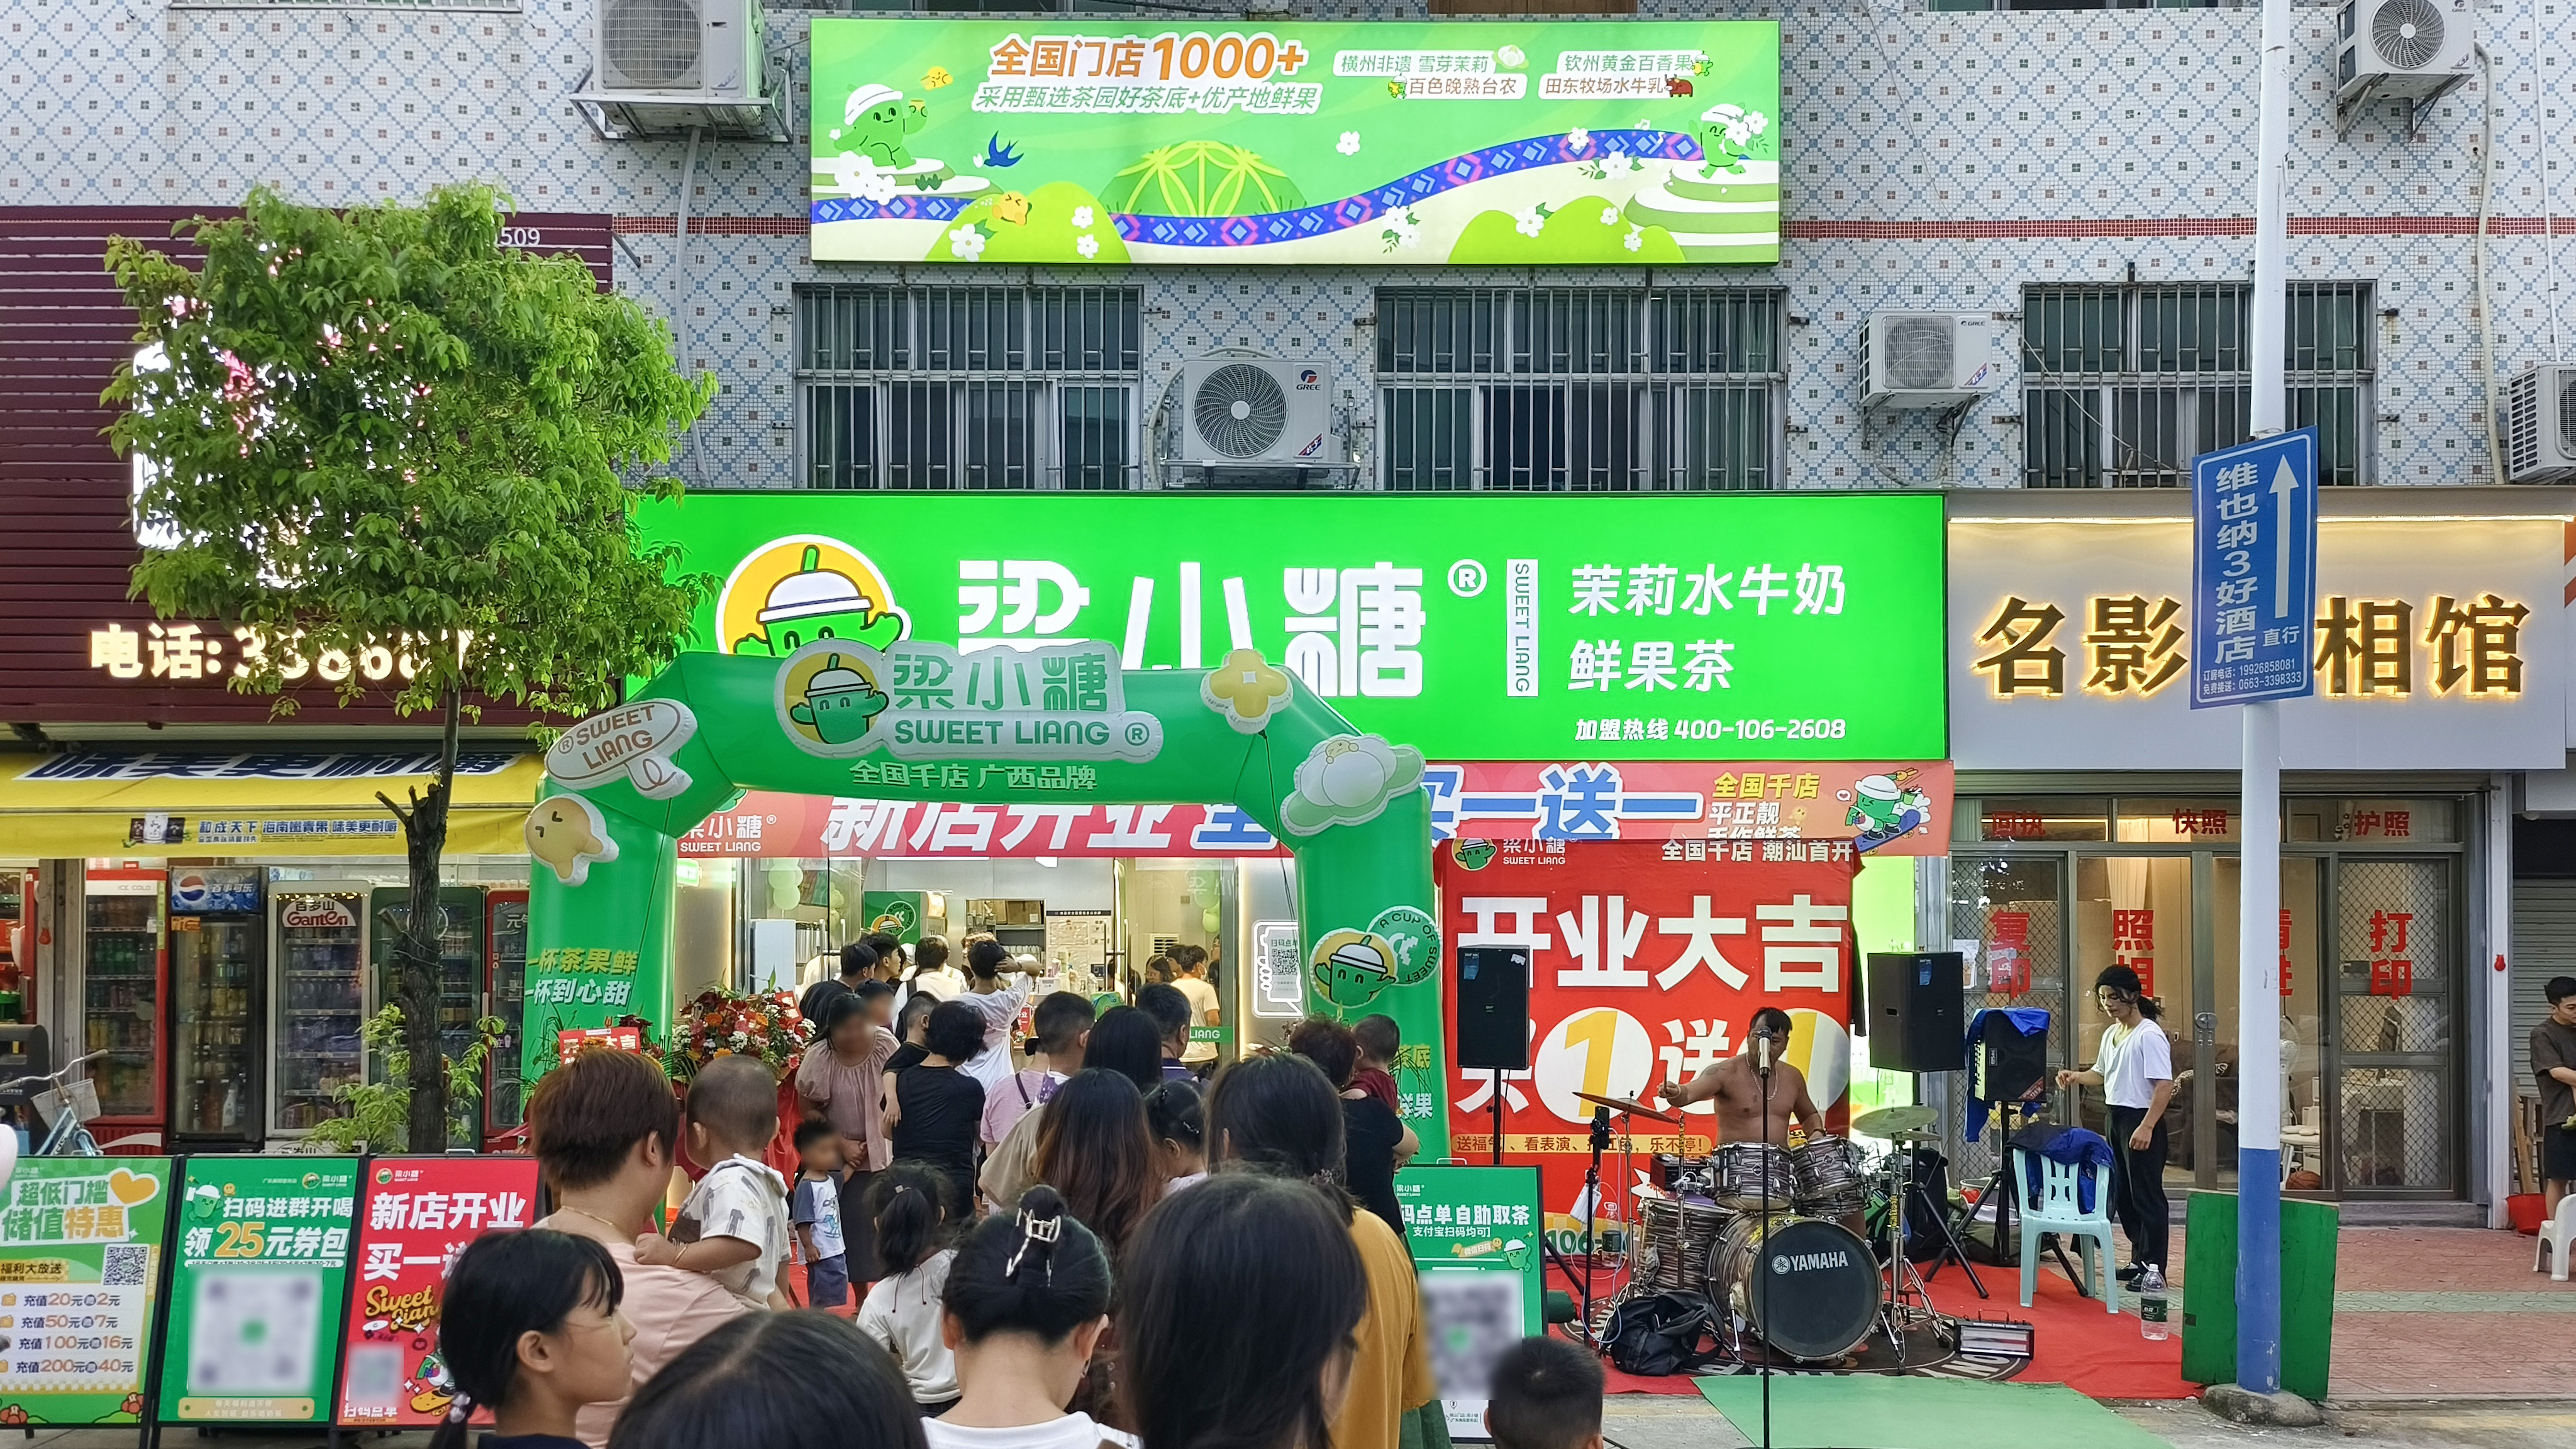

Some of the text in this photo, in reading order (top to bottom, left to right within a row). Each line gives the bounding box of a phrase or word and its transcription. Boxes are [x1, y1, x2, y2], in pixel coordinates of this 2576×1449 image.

[1340, 55, 1489, 73] 横州非遗 雪芽茉莉
[1564, 53, 1692, 74] 钦州黄金百香果
[977, 85, 1318, 110] 采用甄选茶园好茶底+优产地鲜果
[1408, 76, 1517, 96] 百色晚熟台农
[1545, 76, 1665, 96] 田东牧场水牛乳
[2214, 461, 2259, 665] 维也纳3好酒店
[1567, 562, 1846, 618] 茉莉水牛奶
[1514, 563, 1530, 693] SWEET LIANG
[2262, 625, 2300, 647] 直行
[1567, 638, 1736, 693] 鲜果茶
[2238, 658, 2296, 677] 19926858081
[892, 653, 1108, 713] 梁小糖
[2238, 671, 2302, 691] 0663-3398333
[576, 704, 656, 747] SWEET
[894, 719, 1003, 745] SWEET
[1015, 720, 1110, 745] LIANG
[1574, 718, 1847, 741] 加盟热线 400-106-2608
[582, 730, 653, 770] LIANG
[848, 758, 1098, 791] 全国千店 广西品牌
[1711, 771, 1821, 799] 全国千店
[1708, 801, 1780, 826] 平正靓
[2172, 808, 2228, 835] 快照
[2354, 810, 2411, 836] 护照
[680, 841, 762, 853] SWEET LIANG
[1662, 839, 1854, 862] 全国千店 潮汕首开
[1502, 857, 1566, 865] SWEET LIANG
[1379, 913, 1438, 982] A CUP OF SWEET
[1989, 909, 2031, 999] 复印
[2369, 909, 2413, 1001] 打印
[527, 947, 639, 976] 一杯茶果鲜
[525, 977, 631, 1006] 一杯到心甜
[1190, 1030, 1220, 1039] LIANG
[16, 1180, 109, 1206] 超低门槛
[222, 1197, 354, 1219] 扫码进群开喝
[370, 1192, 527, 1231] 新店开业
[2, 1205, 125, 1241] 储值特惠
[184, 1221, 350, 1258] 领25元券包
[1790, 1250, 1849, 1272] YAMAHA
[365, 1284, 434, 1317] Sweet
